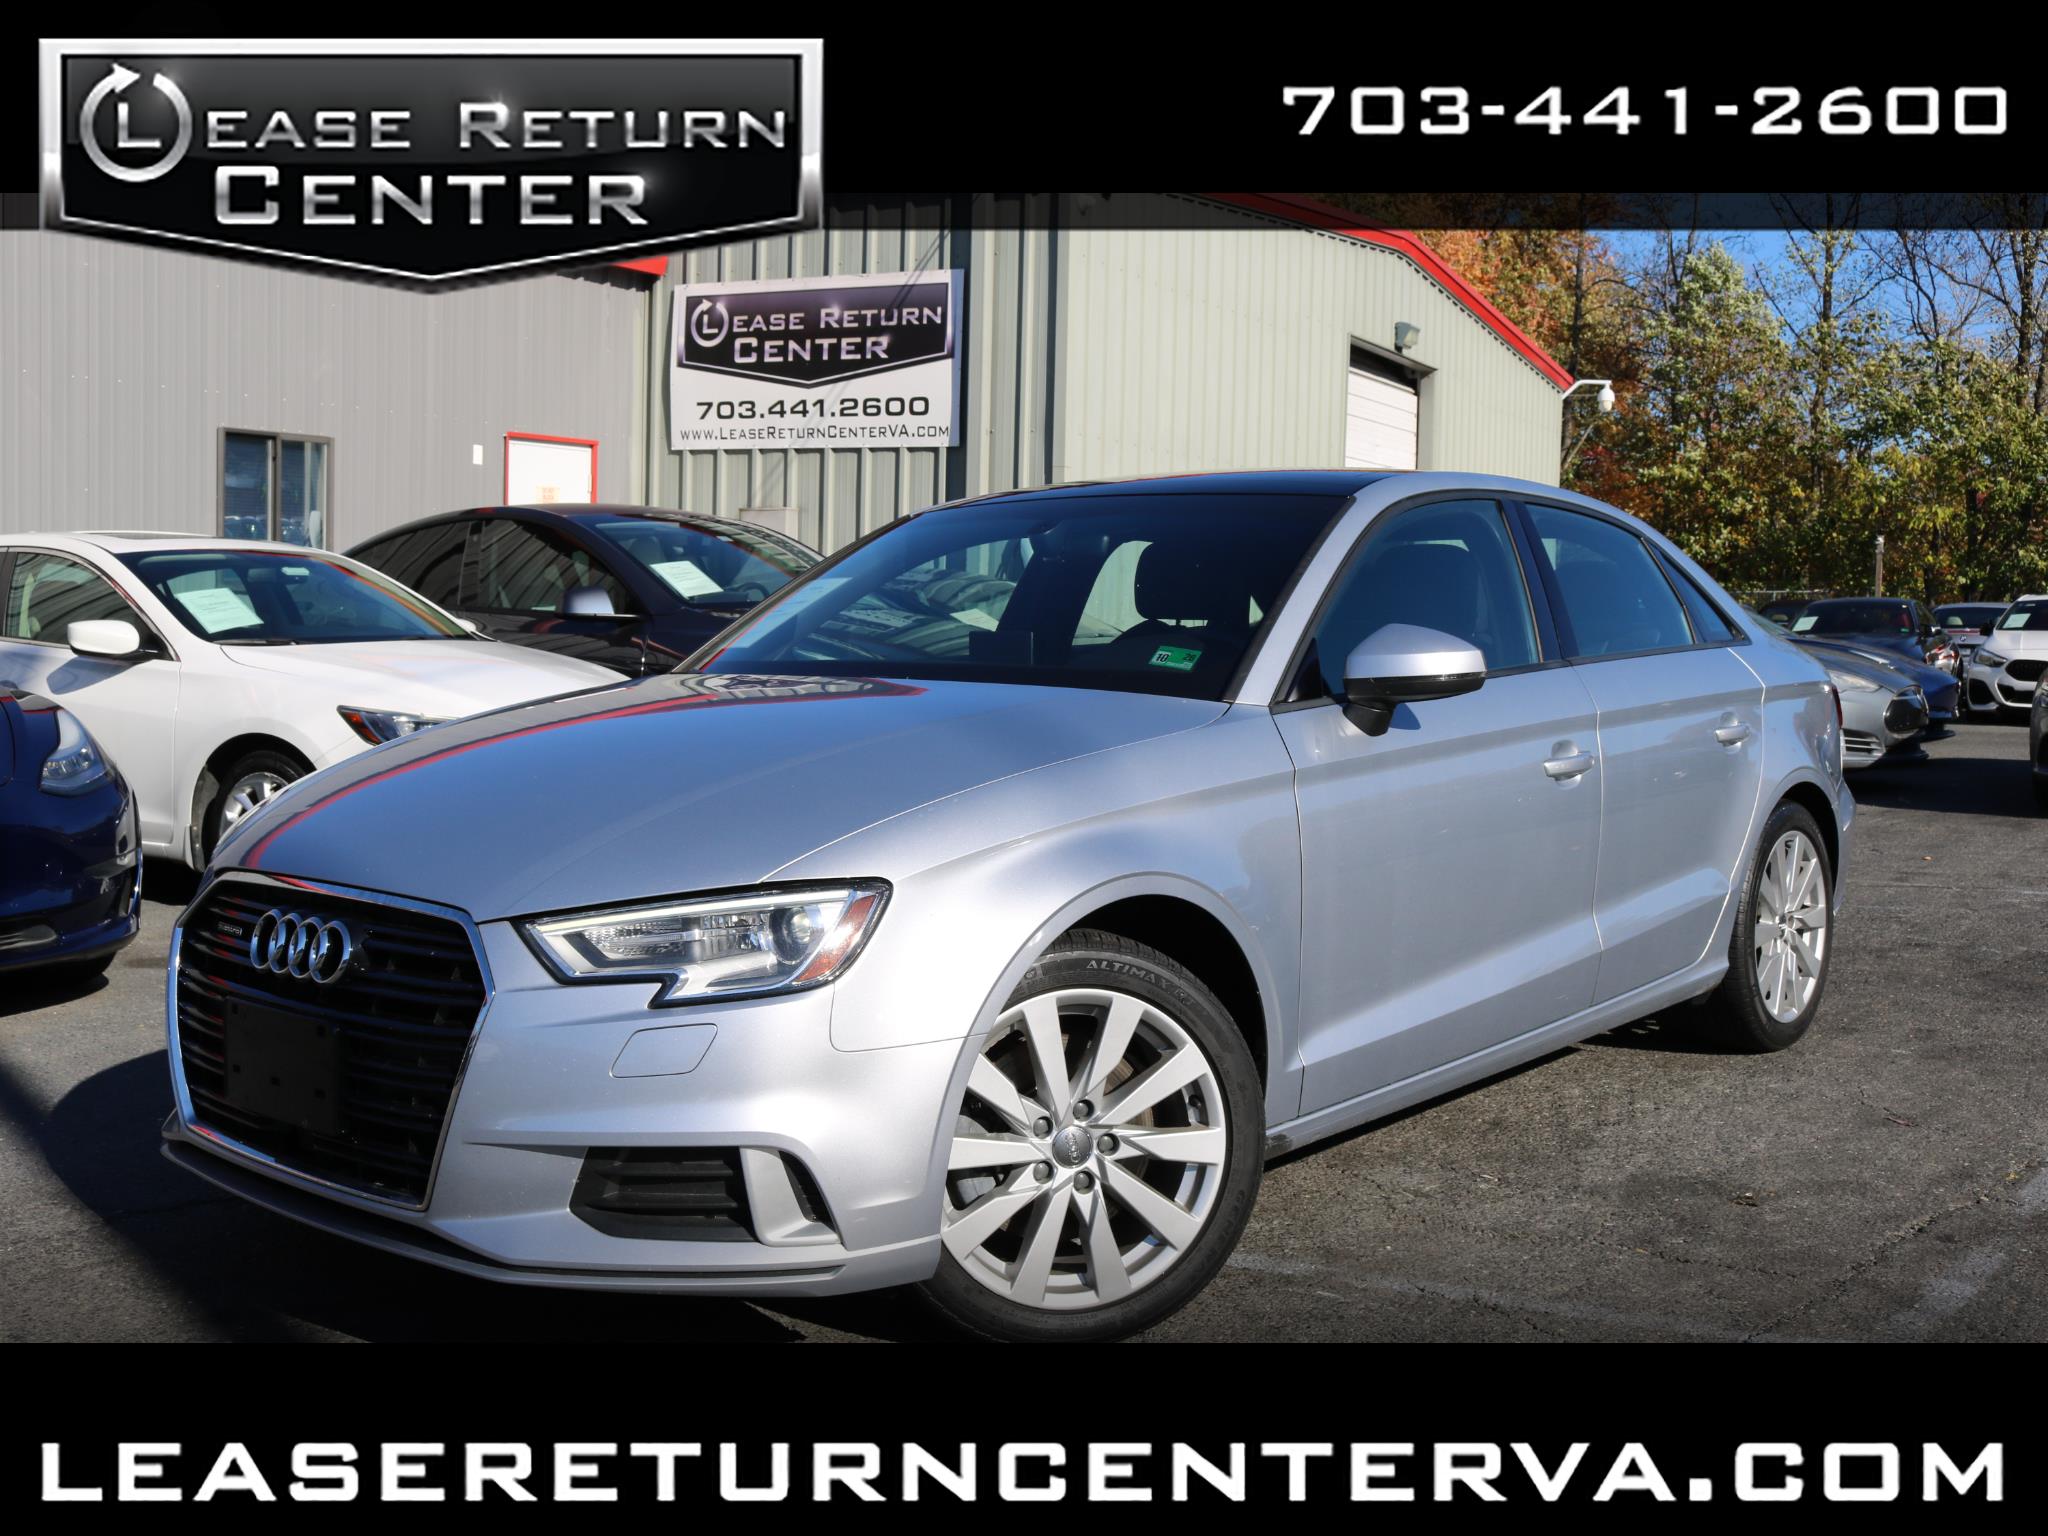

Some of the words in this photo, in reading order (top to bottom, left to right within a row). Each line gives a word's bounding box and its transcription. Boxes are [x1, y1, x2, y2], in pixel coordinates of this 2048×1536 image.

[702, 312, 804, 334] LEASE
[819, 306, 942, 328] RETURN
[734, 336, 890, 364] CENTER
[696, 396, 930, 420] 703.441.2600
[1086, 959, 1171, 989] ALTIMAX
